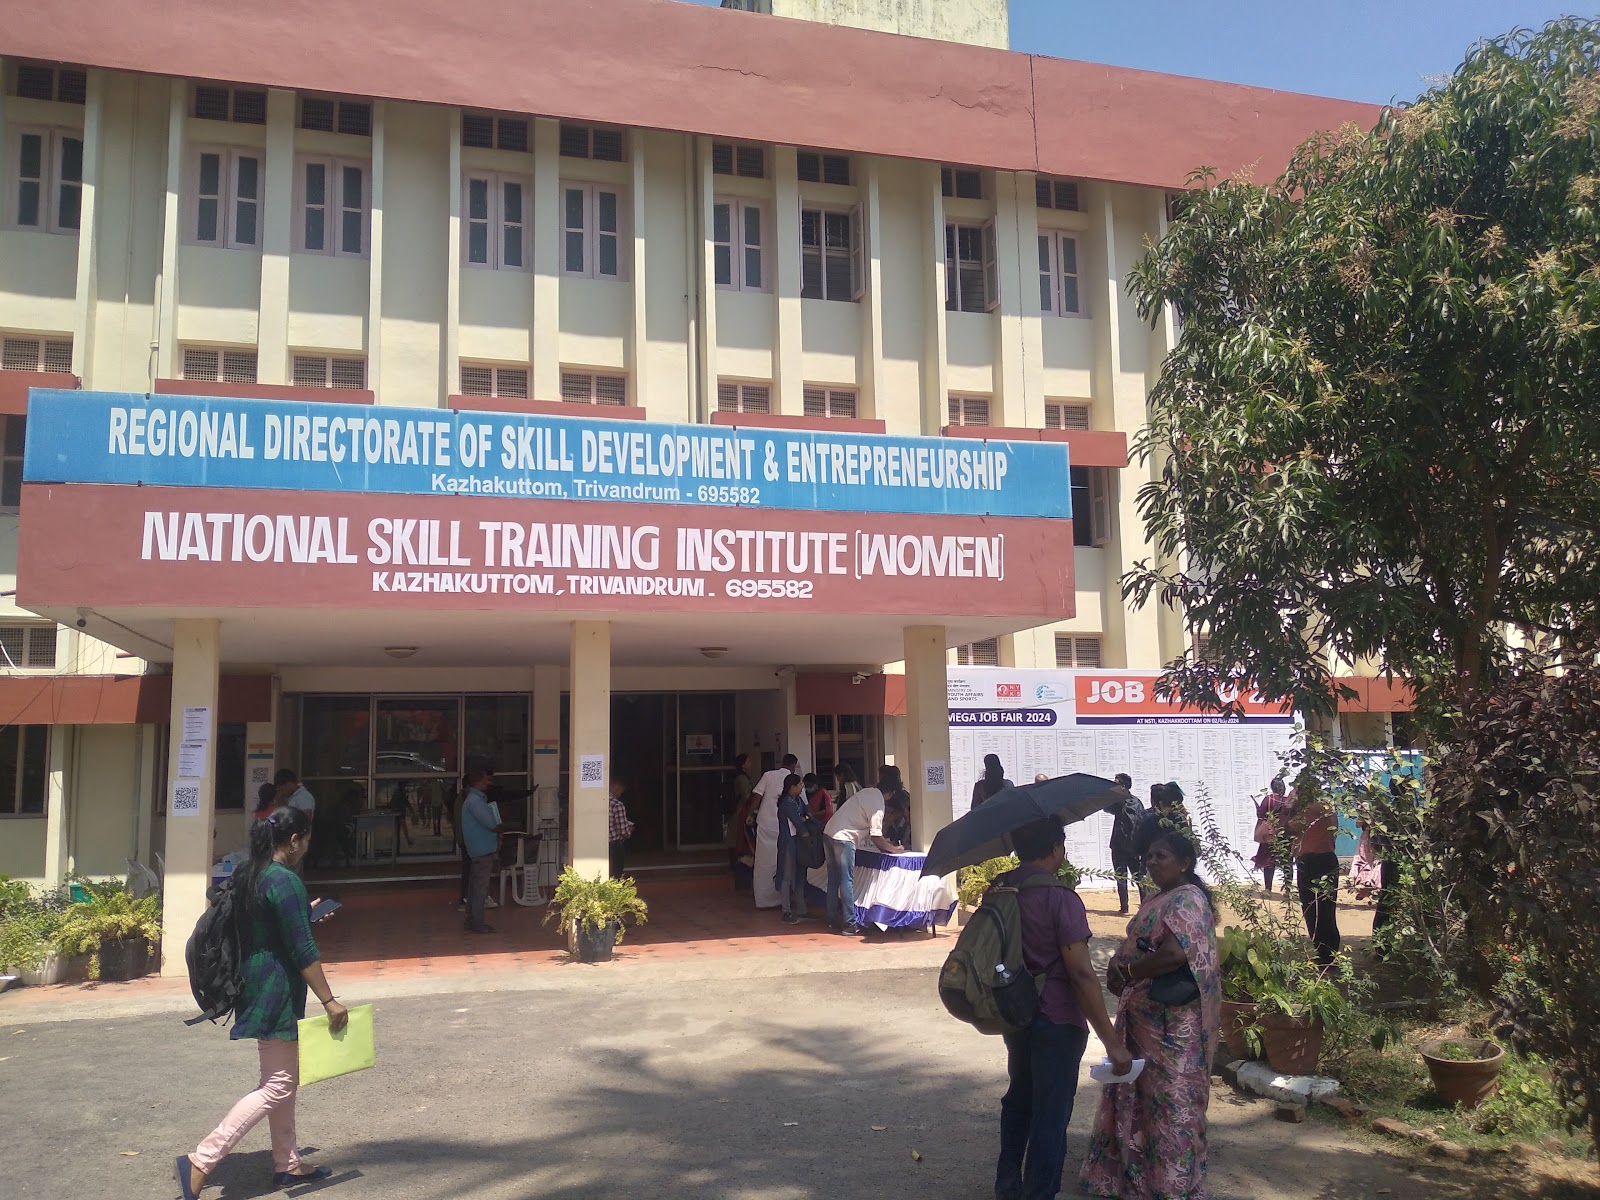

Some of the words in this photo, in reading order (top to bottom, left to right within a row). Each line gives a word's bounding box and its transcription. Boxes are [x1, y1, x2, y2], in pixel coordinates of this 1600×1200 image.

[108, 407, 255, 459] REGIONAL
[264, 413, 451, 466] DIRECTORATE
[459, 423, 493, 468] OF
[500, 425, 574, 475] SKILL
[581, 429, 755, 480] DEVELOPMENT
[764, 440, 780, 482] &
[787, 441, 1008, 491] ENTREPRENEURSHIP
[431, 473, 568, 499] Kazhakuttom,
[573, 480, 680, 500] Trivandrum
[697, 485, 760, 504] 695582
[141, 511, 359, 564] NATIONAL
[367, 517, 471, 566] SKILL
[479, 521, 660, 571] TRAINING
[676, 527, 848, 575] INSTITUTE
[725, 579, 813, 599] 695582
[1087, 680, 1145, 703] JOB
[948, 713, 977, 722] MEGA
[979, 713, 998, 722] JOB
[1001, 712, 1023, 722] FAIR
[1026, 712, 1051, 722] 2024
